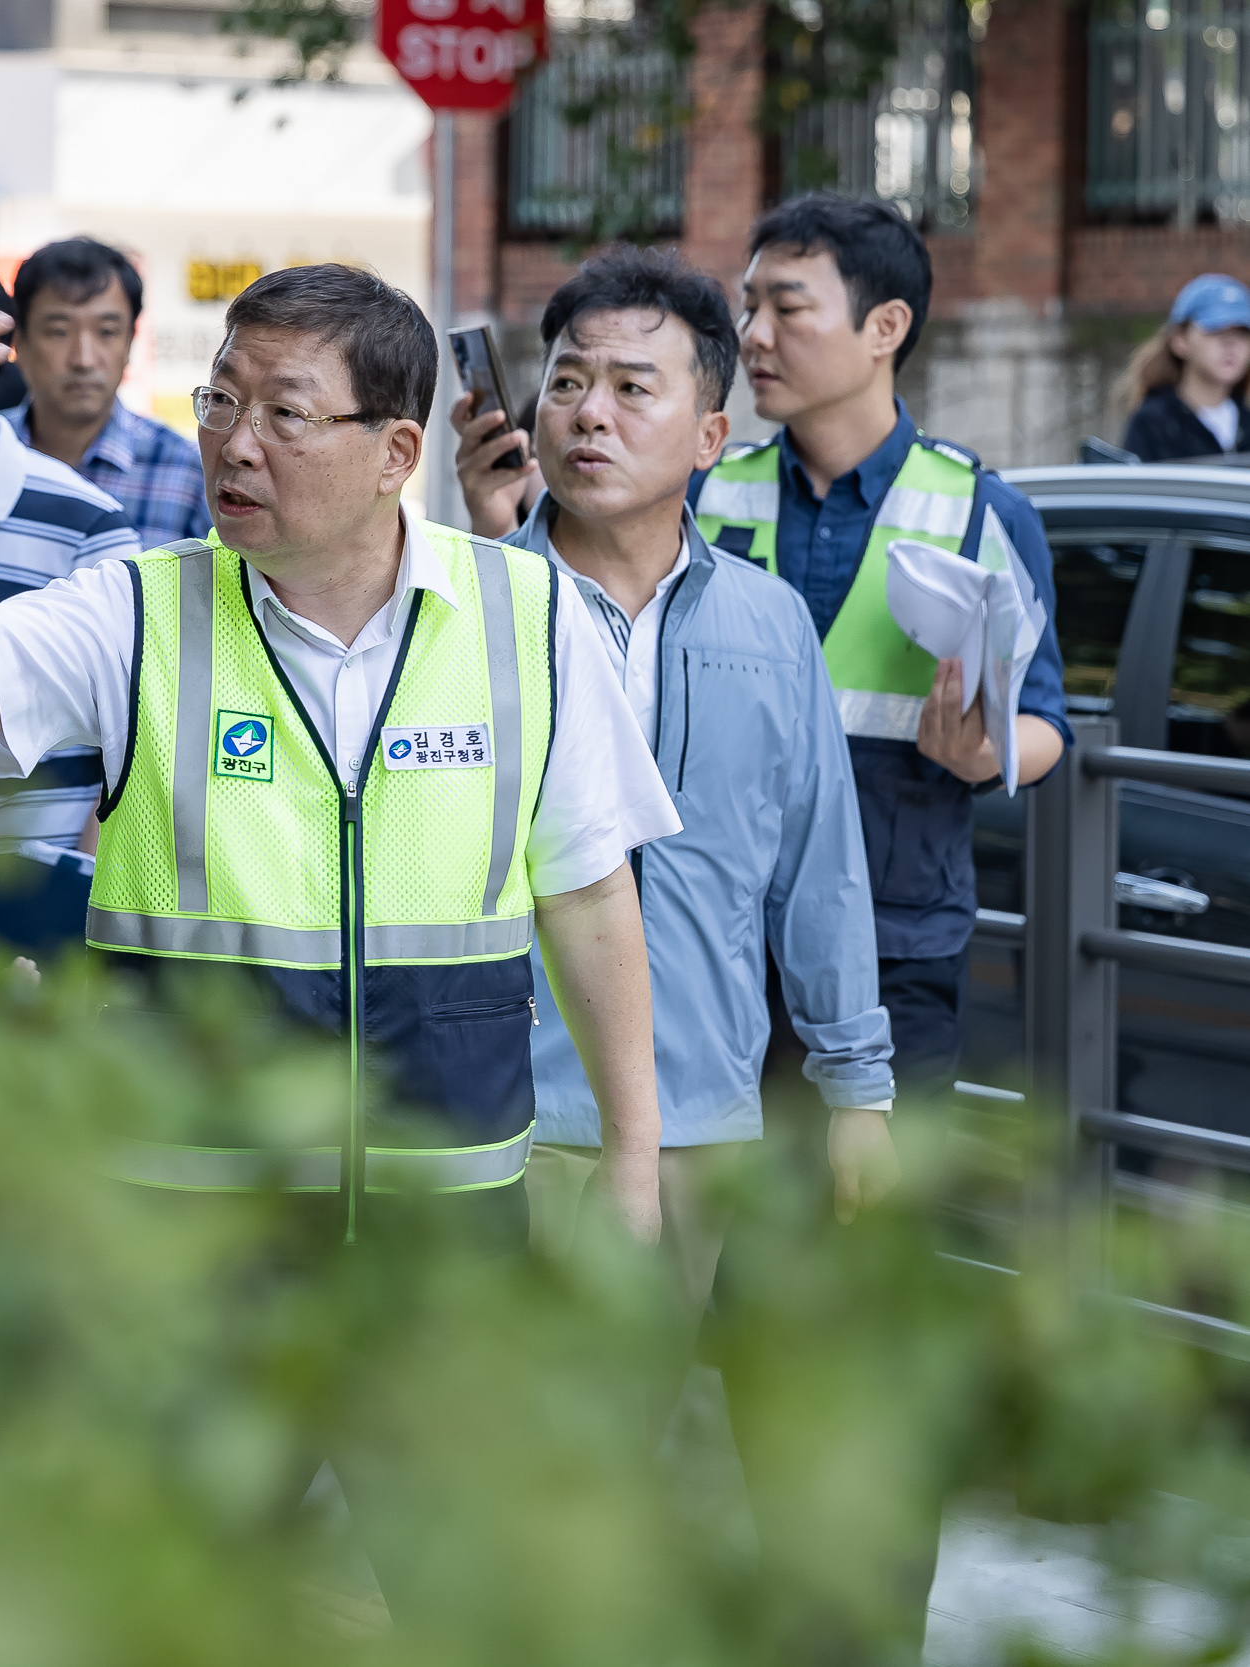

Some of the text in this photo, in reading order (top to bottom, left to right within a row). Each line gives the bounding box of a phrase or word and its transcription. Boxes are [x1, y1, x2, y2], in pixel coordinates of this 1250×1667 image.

[396, 22, 536, 84] STOP
[415, 748, 485, 764] 광진구청장
[220, 757, 267, 774] 광진구
